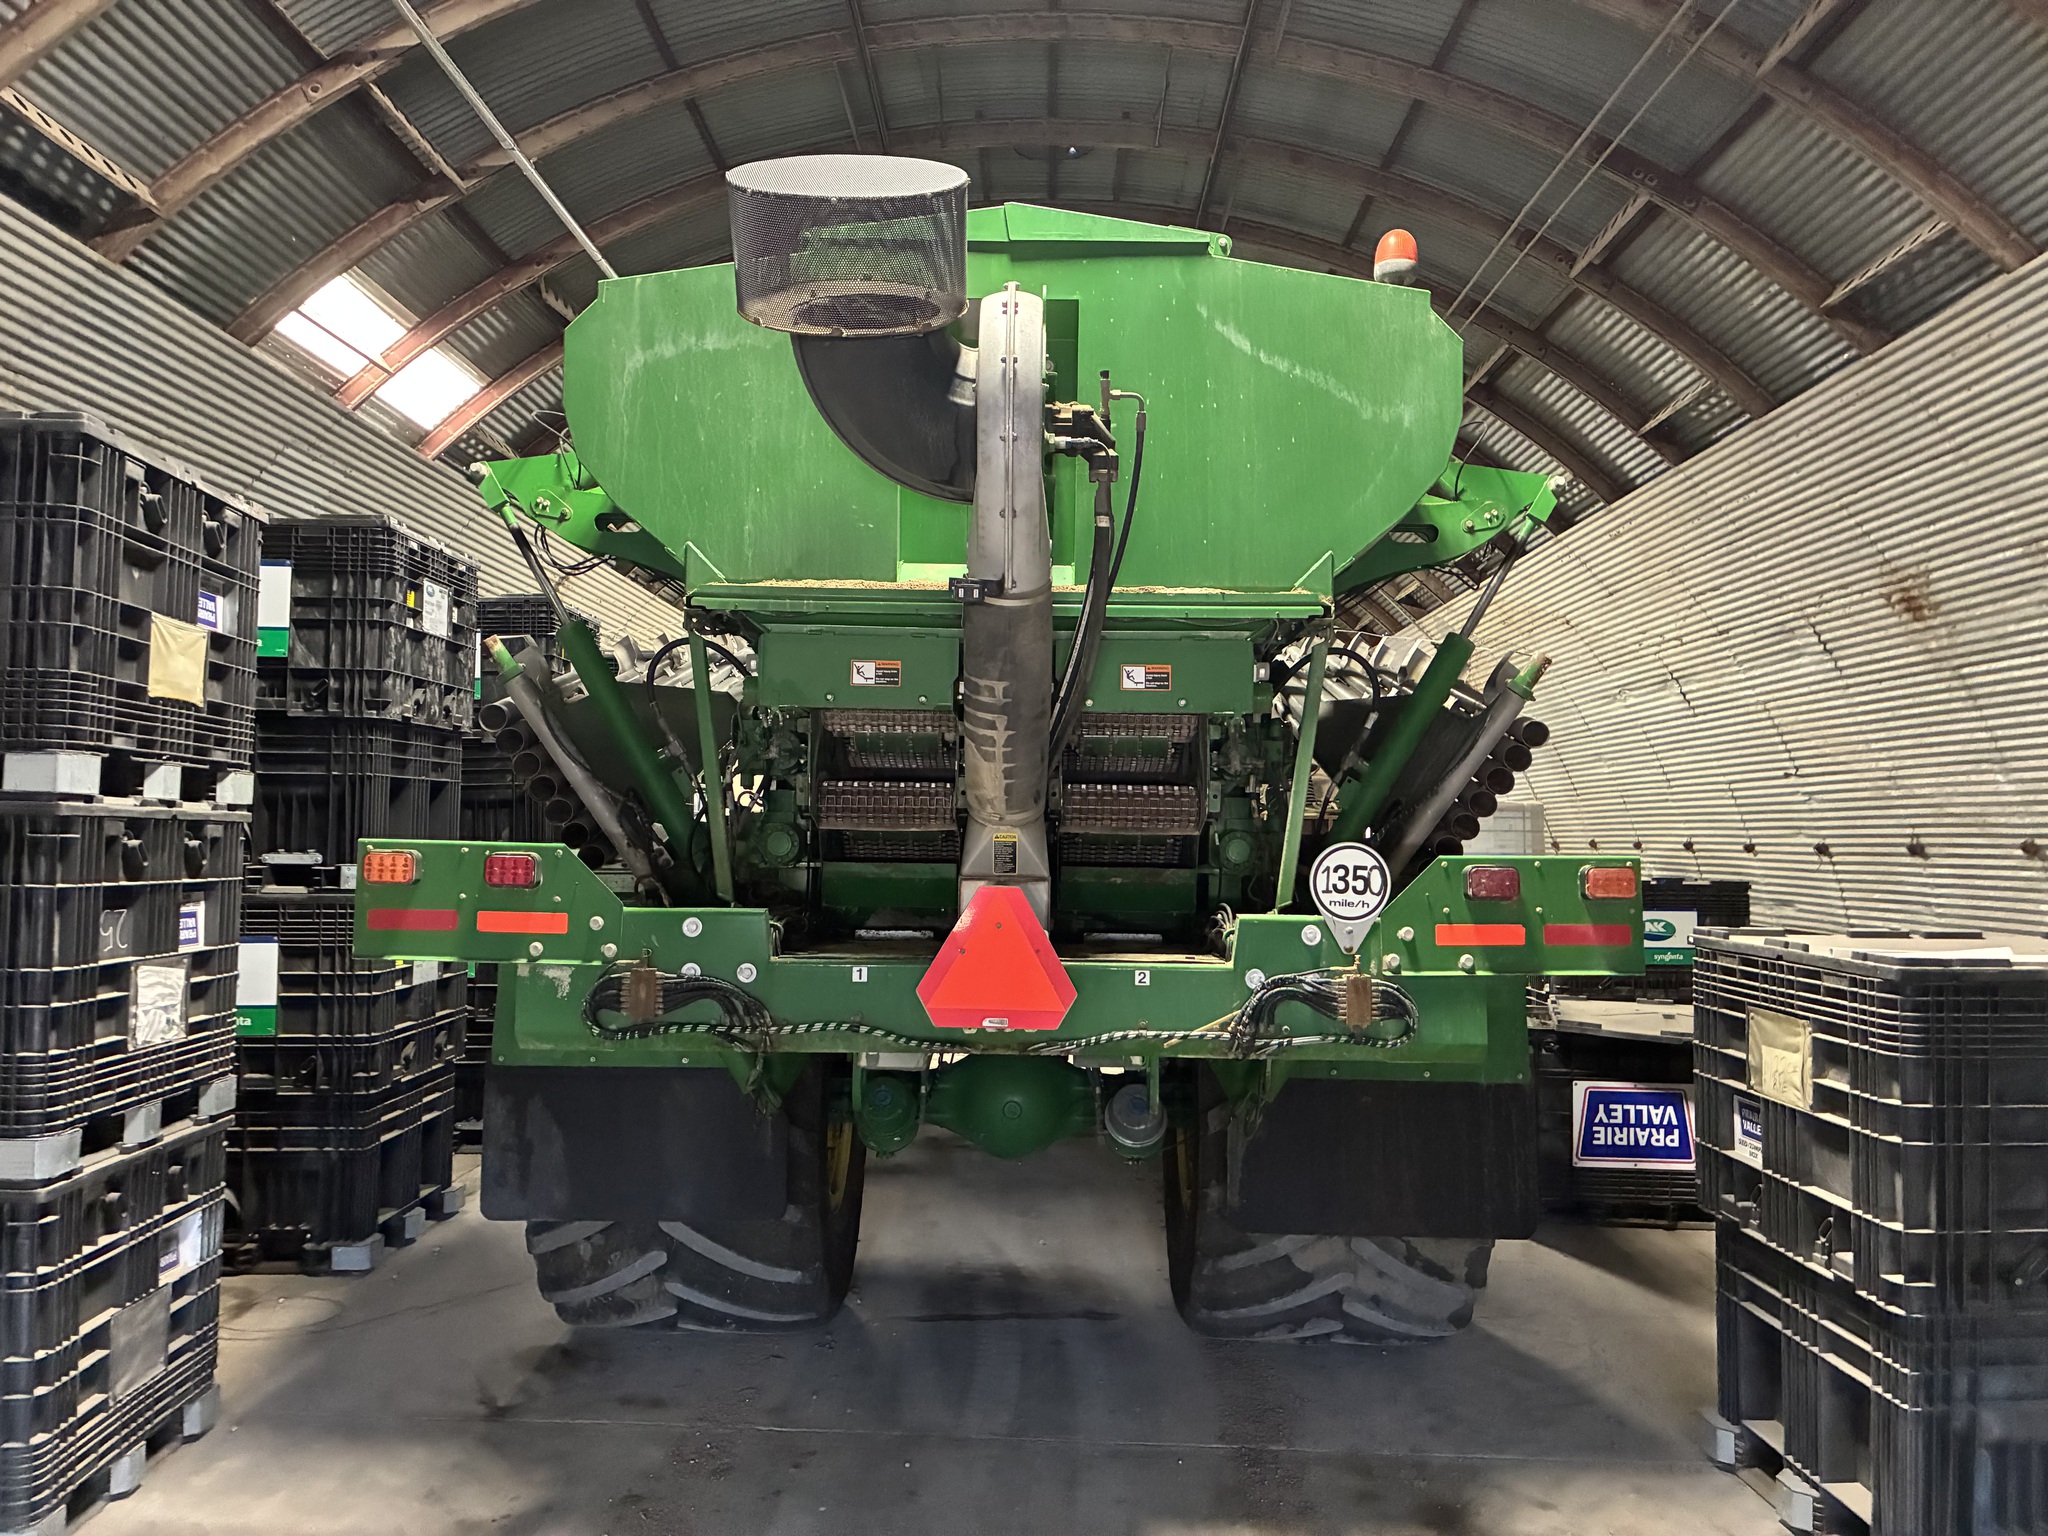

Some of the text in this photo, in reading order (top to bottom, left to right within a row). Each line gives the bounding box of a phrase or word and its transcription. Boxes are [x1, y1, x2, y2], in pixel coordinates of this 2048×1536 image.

[1329, 899, 1370, 908] mile/h
[1645, 921, 1667, 932] NK
[1654, 952, 1684, 961] syngenta
[856, 967, 863, 980] 1
[1138, 971, 1147, 984] 2
[1593, 1103, 1678, 1126] VALLEY
[1742, 1118, 1762, 1136] VALLE
[1592, 1126, 1680, 1147] PRAIRIE
